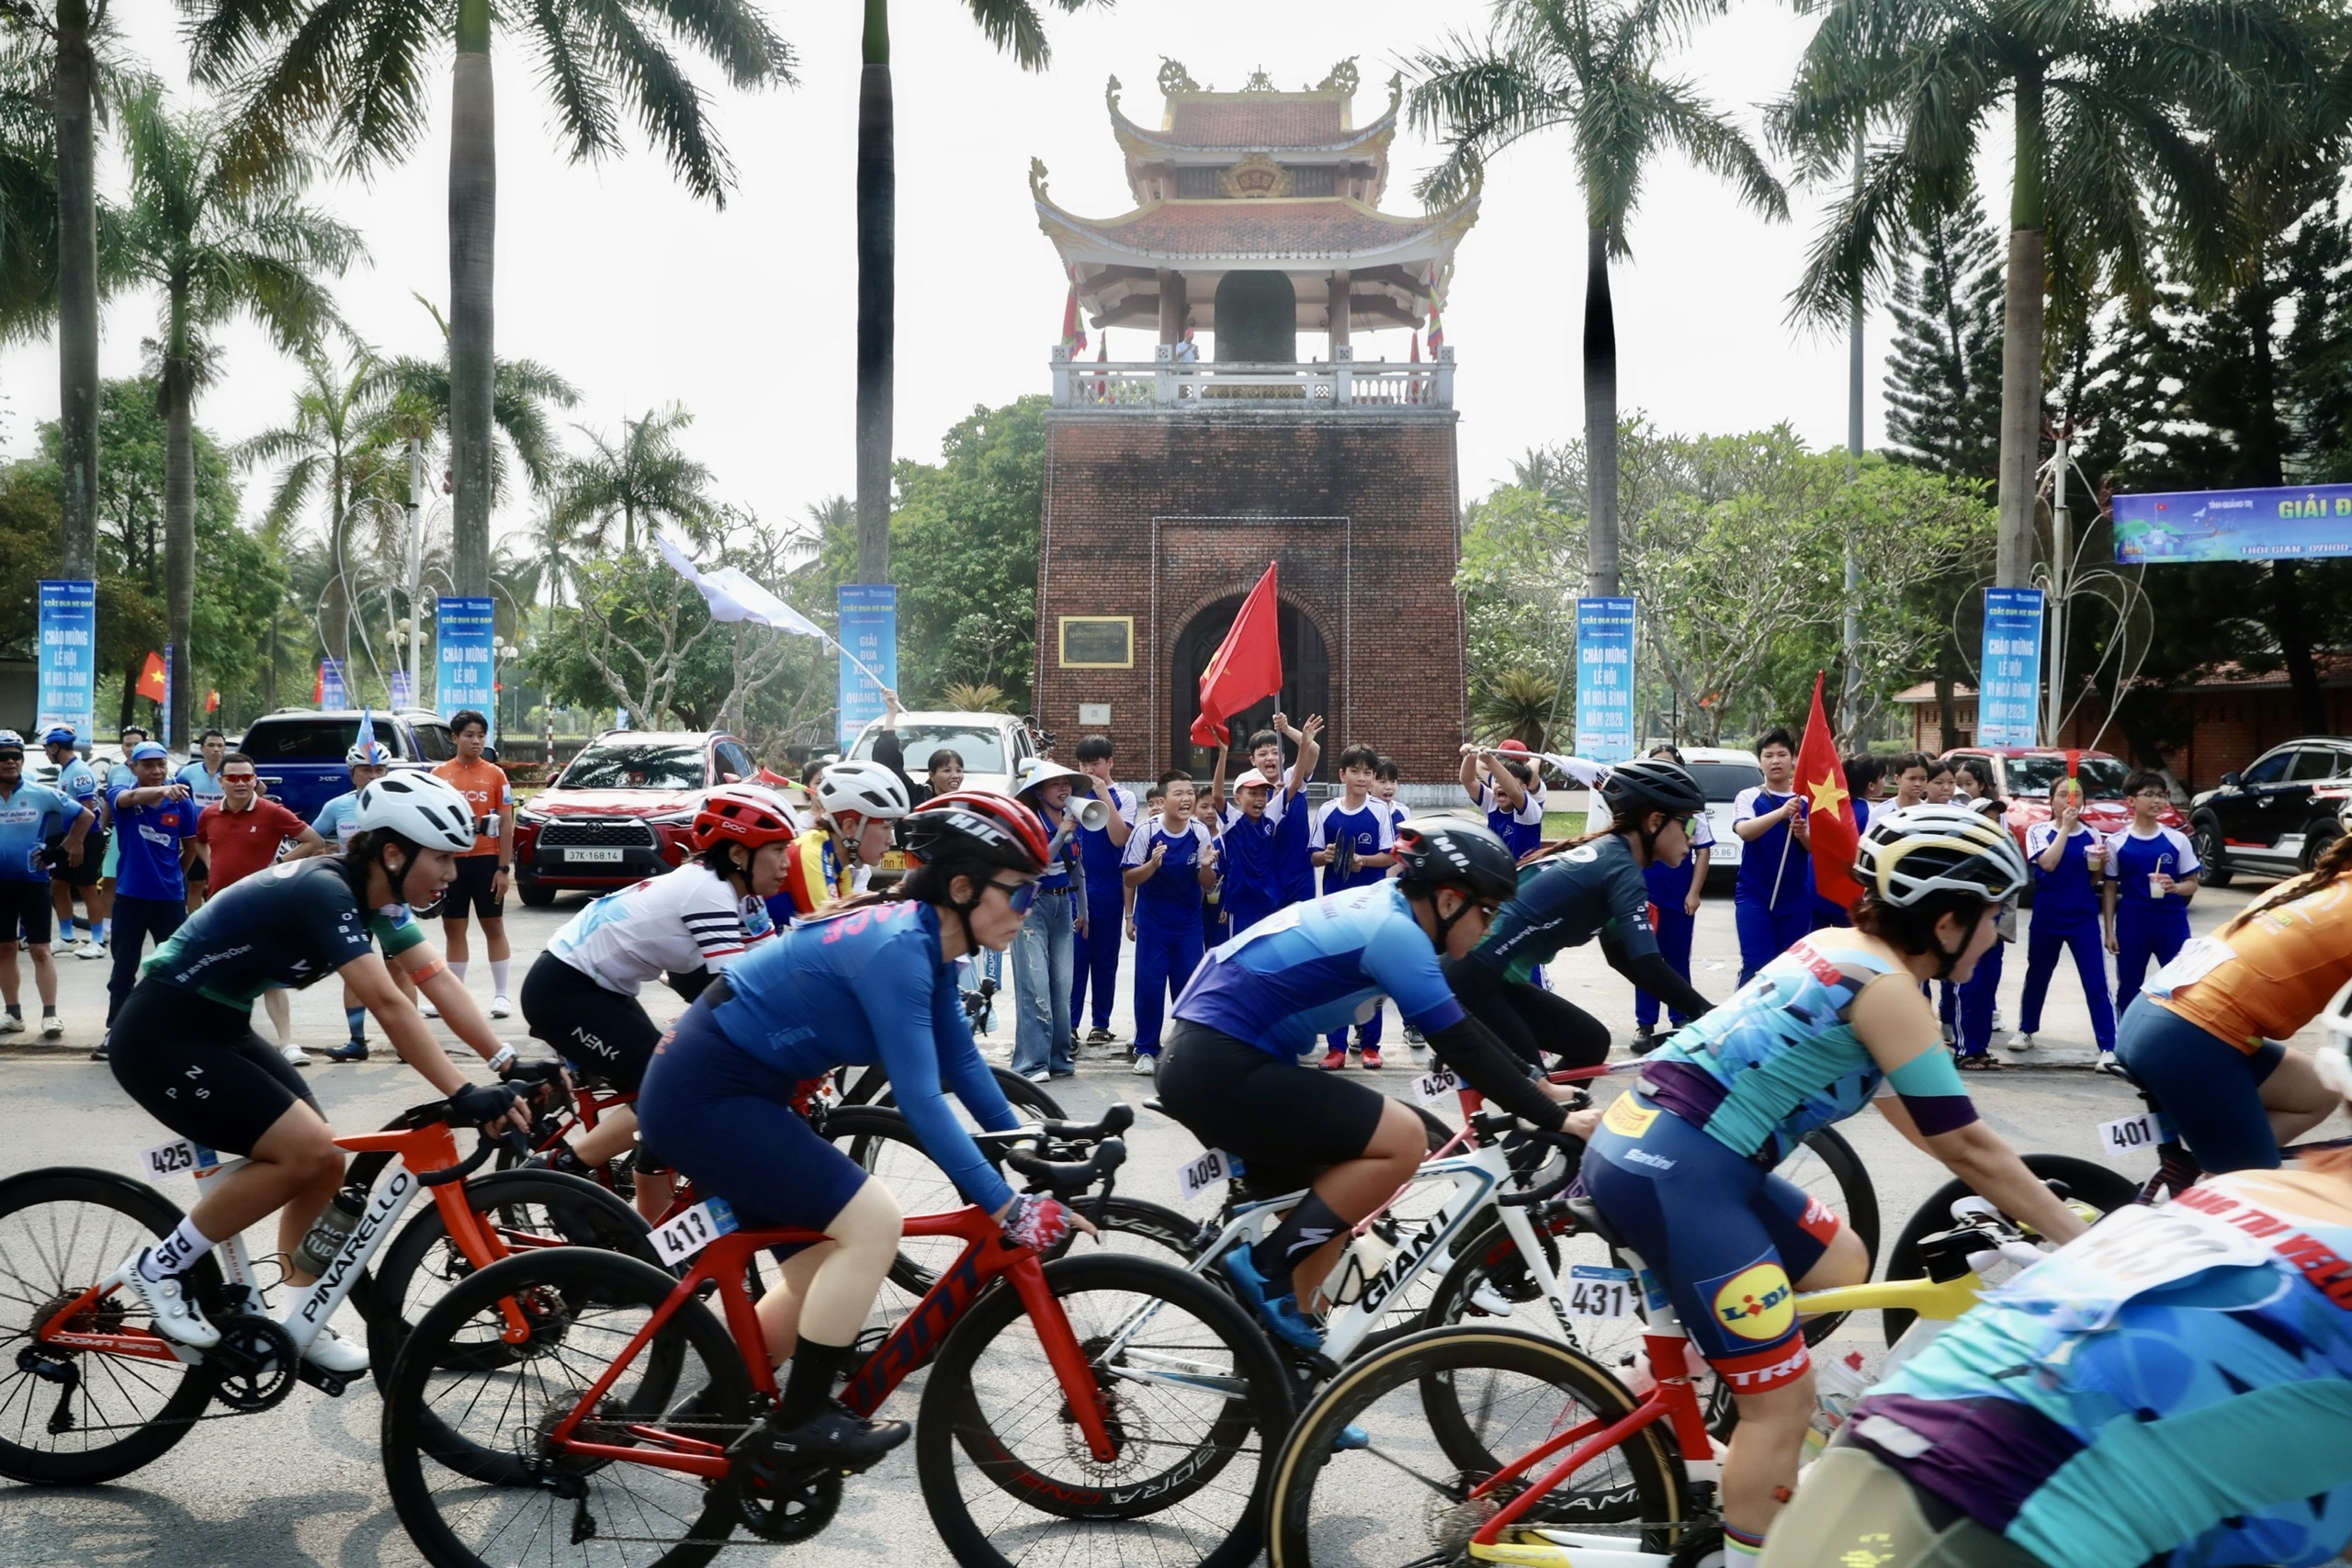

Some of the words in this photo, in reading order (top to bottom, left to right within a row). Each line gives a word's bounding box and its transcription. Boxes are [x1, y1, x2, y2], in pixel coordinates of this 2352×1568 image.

[2278, 493, 2327, 519] GIẢI
[45, 626, 64, 645] CHÀO
[64, 626, 88, 646] MỪNG
[860, 633, 876, 647] GIẢI
[1988, 636, 2009, 654] CHÀO
[2012, 637, 2034, 656] MỪNG
[54, 646, 62, 666] LỄ
[64, 648, 77, 669] HỘI
[443, 645, 463, 662] CHÀO
[465, 645, 488, 662] MỪNG
[860, 650, 876, 661] ĐUA
[1583, 645, 1604, 663] CHÀO
[1604, 645, 1627, 663] MỪNG
[44, 669, 51, 685] VÌ
[68, 669, 87, 687] BÌNH
[454, 663, 463, 683] LỄ
[465, 665, 478, 687] HỘI
[1593, 664, 1602, 685] LỄ
[1604, 667, 1617, 688] HỘI
[1998, 656, 2007, 676] LỄ
[2008, 658, 2021, 680] HỘI
[443, 685, 450, 704] VÌ
[469, 686, 488, 704] BÌNH
[846, 689, 876, 705] QUẢNG
[1583, 687, 1590, 705] VÌ
[1608, 687, 1626, 705] BÌNH
[1986, 678, 1995, 696] VÌ
[2012, 680, 2031, 698] BÌNH
[47, 690, 63, 707] NĂM
[64, 693, 83, 707] 2026
[1586, 709, 1603, 727] NĂM
[1604, 713, 1623, 728] 2026
[1989, 700, 2007, 718] NĂM
[2008, 704, 2027, 719] 2026
[722, 821, 746, 834] POC
[945, 813, 1010, 847] HJC
[1422, 1069, 1455, 1097] 426
[2111, 1118, 2152, 1148] 401
[151, 1143, 192, 1174] 425
[1187, 1154, 1222, 1190] 409
[663, 1212, 707, 1253] 413
[301, 1172, 408, 1324] PINARELLO
[1571, 1282, 1623, 1317] 431
[1549, 1295, 1586, 1350] GIAN
[118, 1341, 162, 1352] SHIMANO
